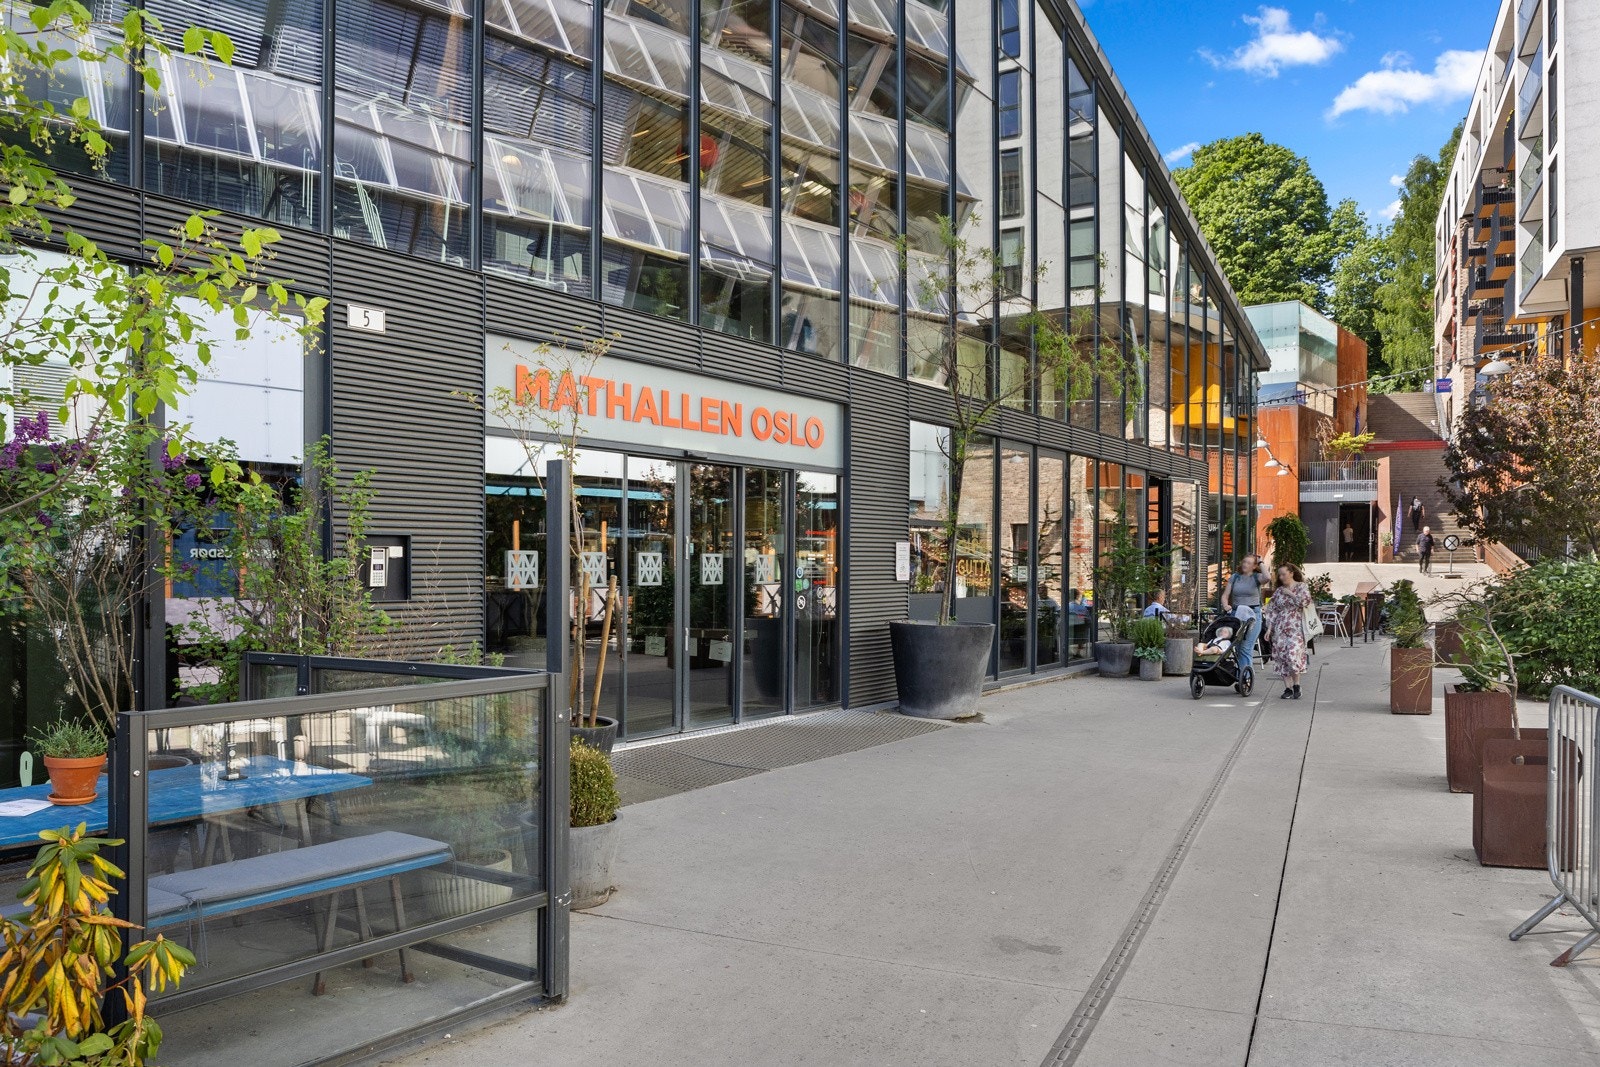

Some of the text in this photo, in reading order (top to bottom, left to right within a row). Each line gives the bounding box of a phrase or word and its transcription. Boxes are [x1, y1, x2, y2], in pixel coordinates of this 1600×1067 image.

[363, 310, 370, 327] 5
[515, 364, 825, 449] MATHALLEN OSLO
[957, 558, 991, 577] GUTTA
